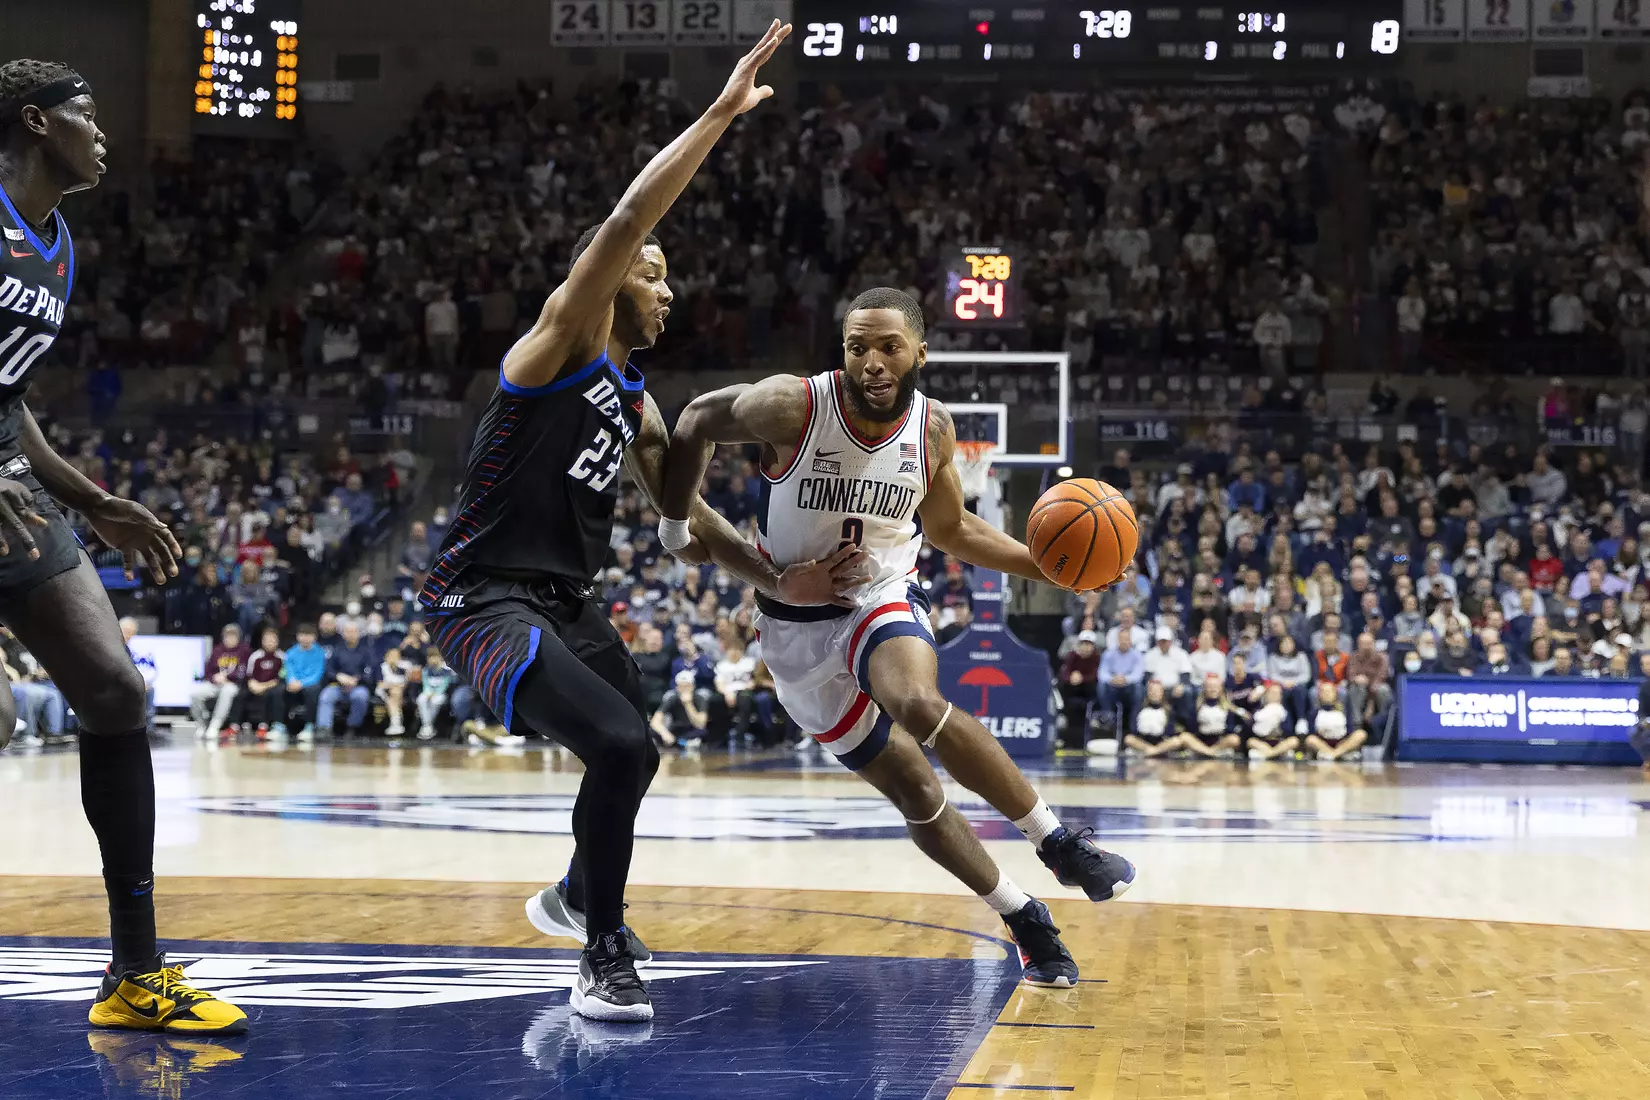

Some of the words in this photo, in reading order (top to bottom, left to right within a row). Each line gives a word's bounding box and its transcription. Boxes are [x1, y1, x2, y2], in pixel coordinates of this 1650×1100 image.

[559, 4, 599, 29] 24
[626, 4, 655, 29] 13
[682, 3, 719, 29] 22
[1079, 10, 1132, 39] 7:28
[803, 22, 844, 57] 23
[965, 254, 1011, 281] 7:28
[0, 274, 65, 327] DEPAU
[955, 278, 1004, 320] 24
[0, 326, 57, 386] 10
[567, 427, 623, 492] 23
[797, 477, 916, 520] CONNECTICUT
[439, 594, 465, 608] AUL
[1430, 692, 1516, 714] UCONN
[977, 716, 1042, 739] ELERS
